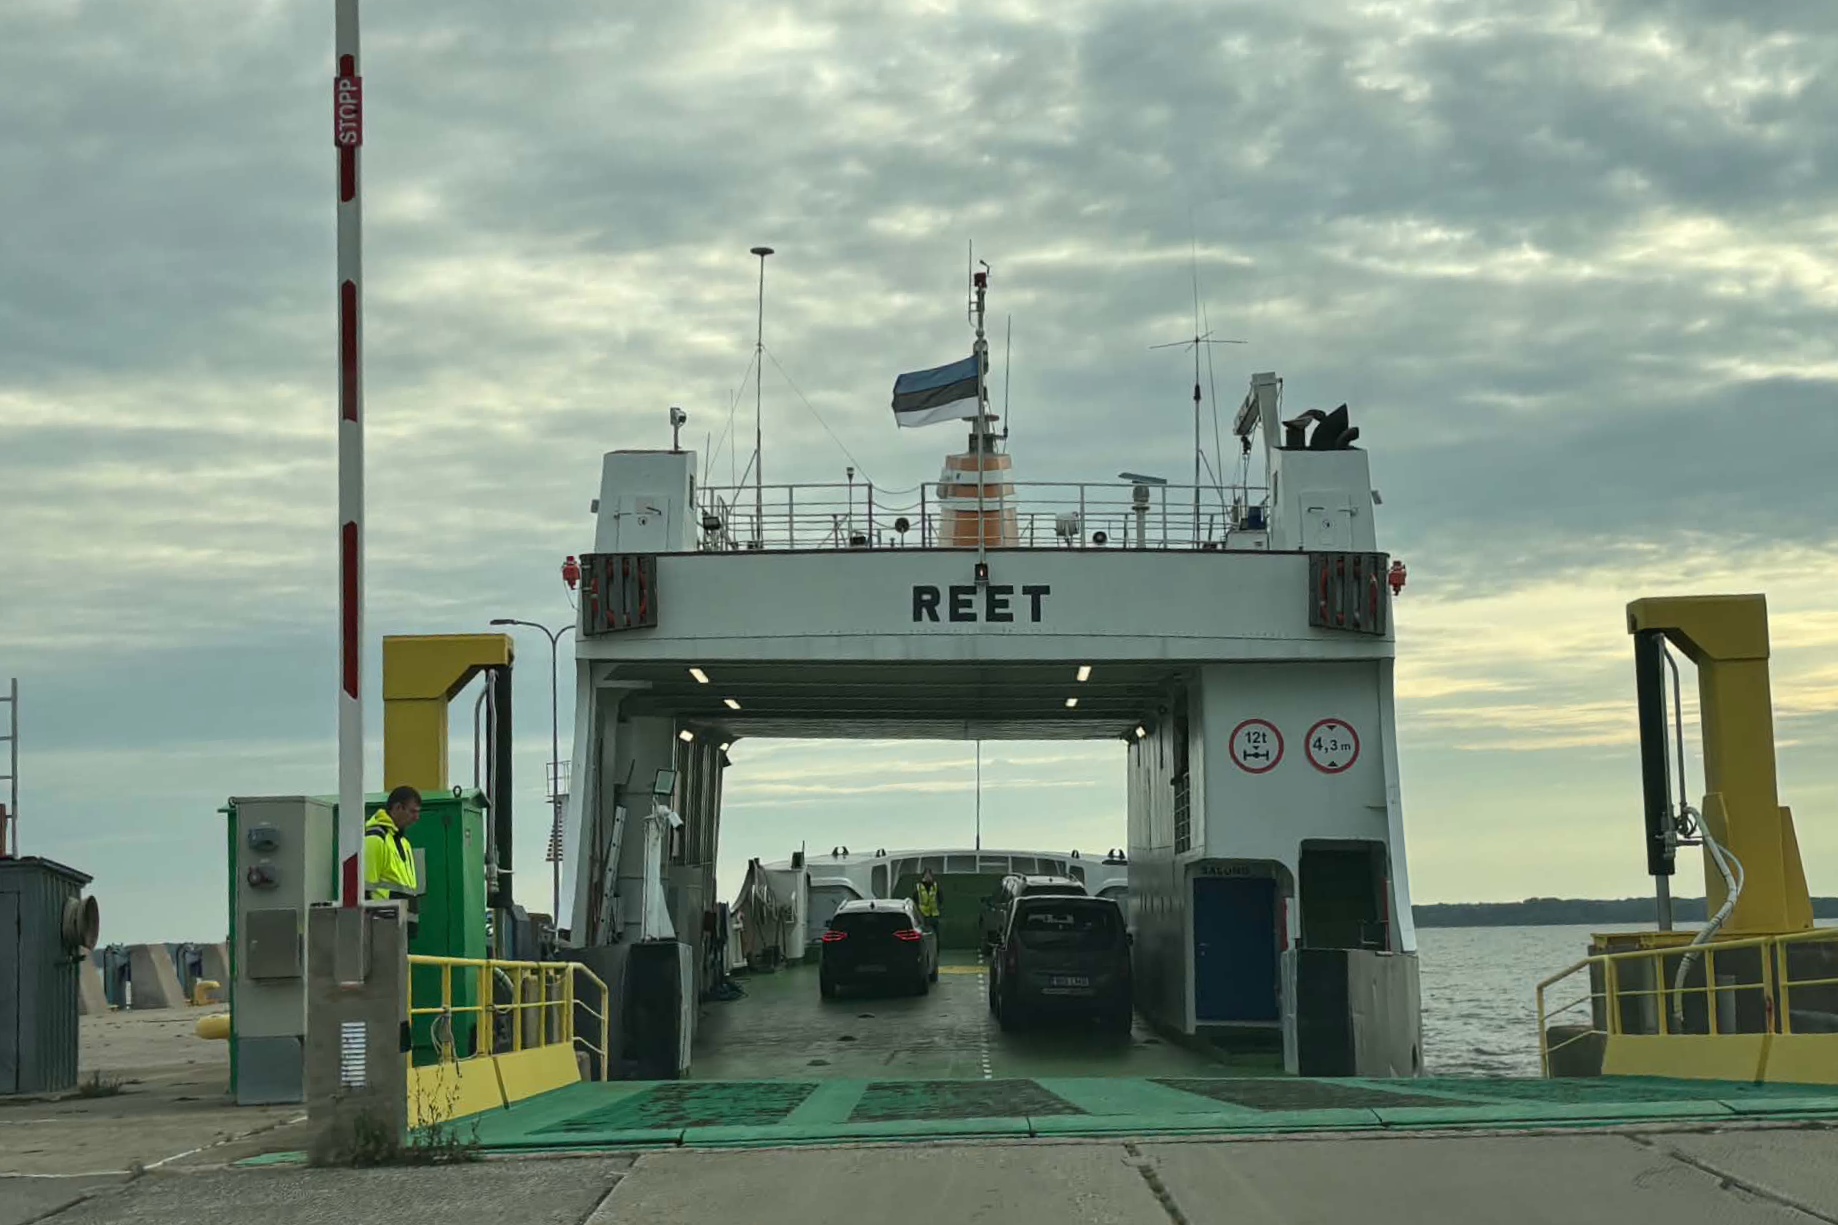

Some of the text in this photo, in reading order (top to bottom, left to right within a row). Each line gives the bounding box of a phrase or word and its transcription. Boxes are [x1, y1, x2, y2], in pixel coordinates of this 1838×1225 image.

[339, 79, 358, 143] STOPP
[912, 585, 1050, 622] REET
[1245, 731, 1267, 743] 12t
